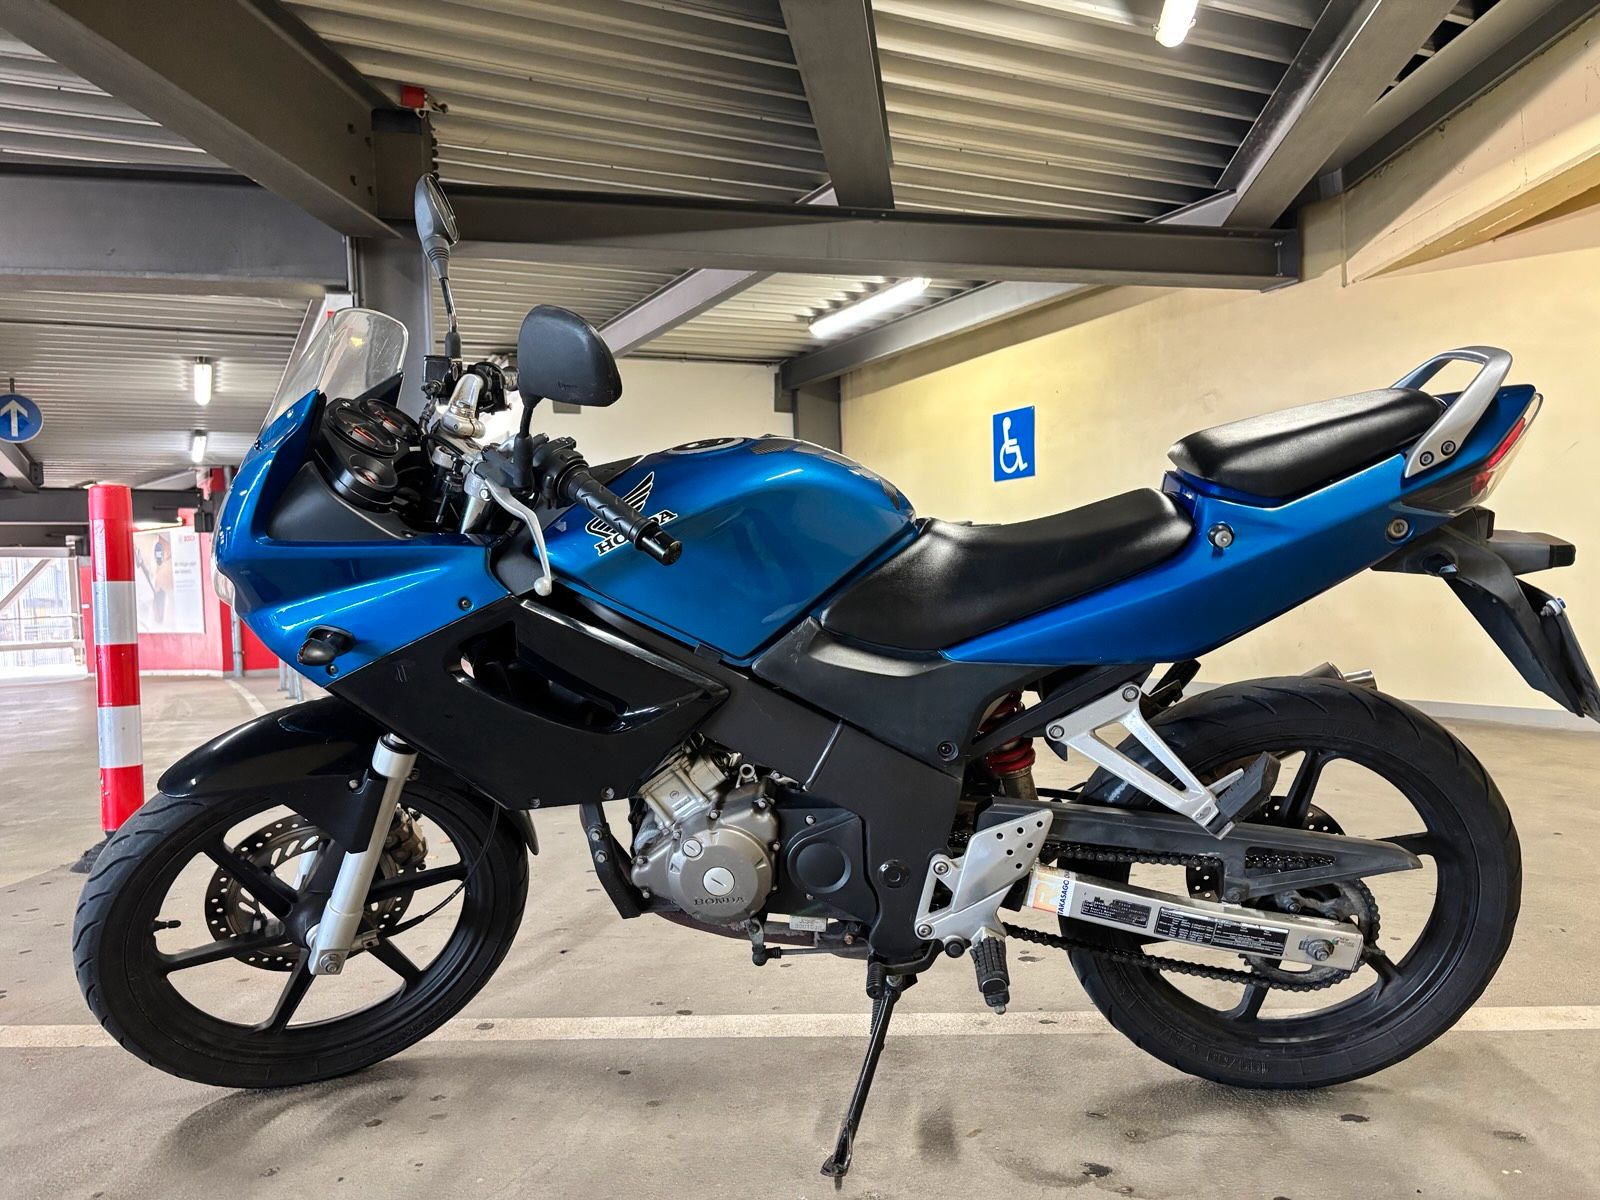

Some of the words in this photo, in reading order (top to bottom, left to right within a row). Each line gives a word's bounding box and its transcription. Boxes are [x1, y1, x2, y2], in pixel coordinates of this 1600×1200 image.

[595, 510, 677, 555] HOA
[694, 897, 744, 905] HONDA
[1057, 879, 1070, 915] TAKASAGO
